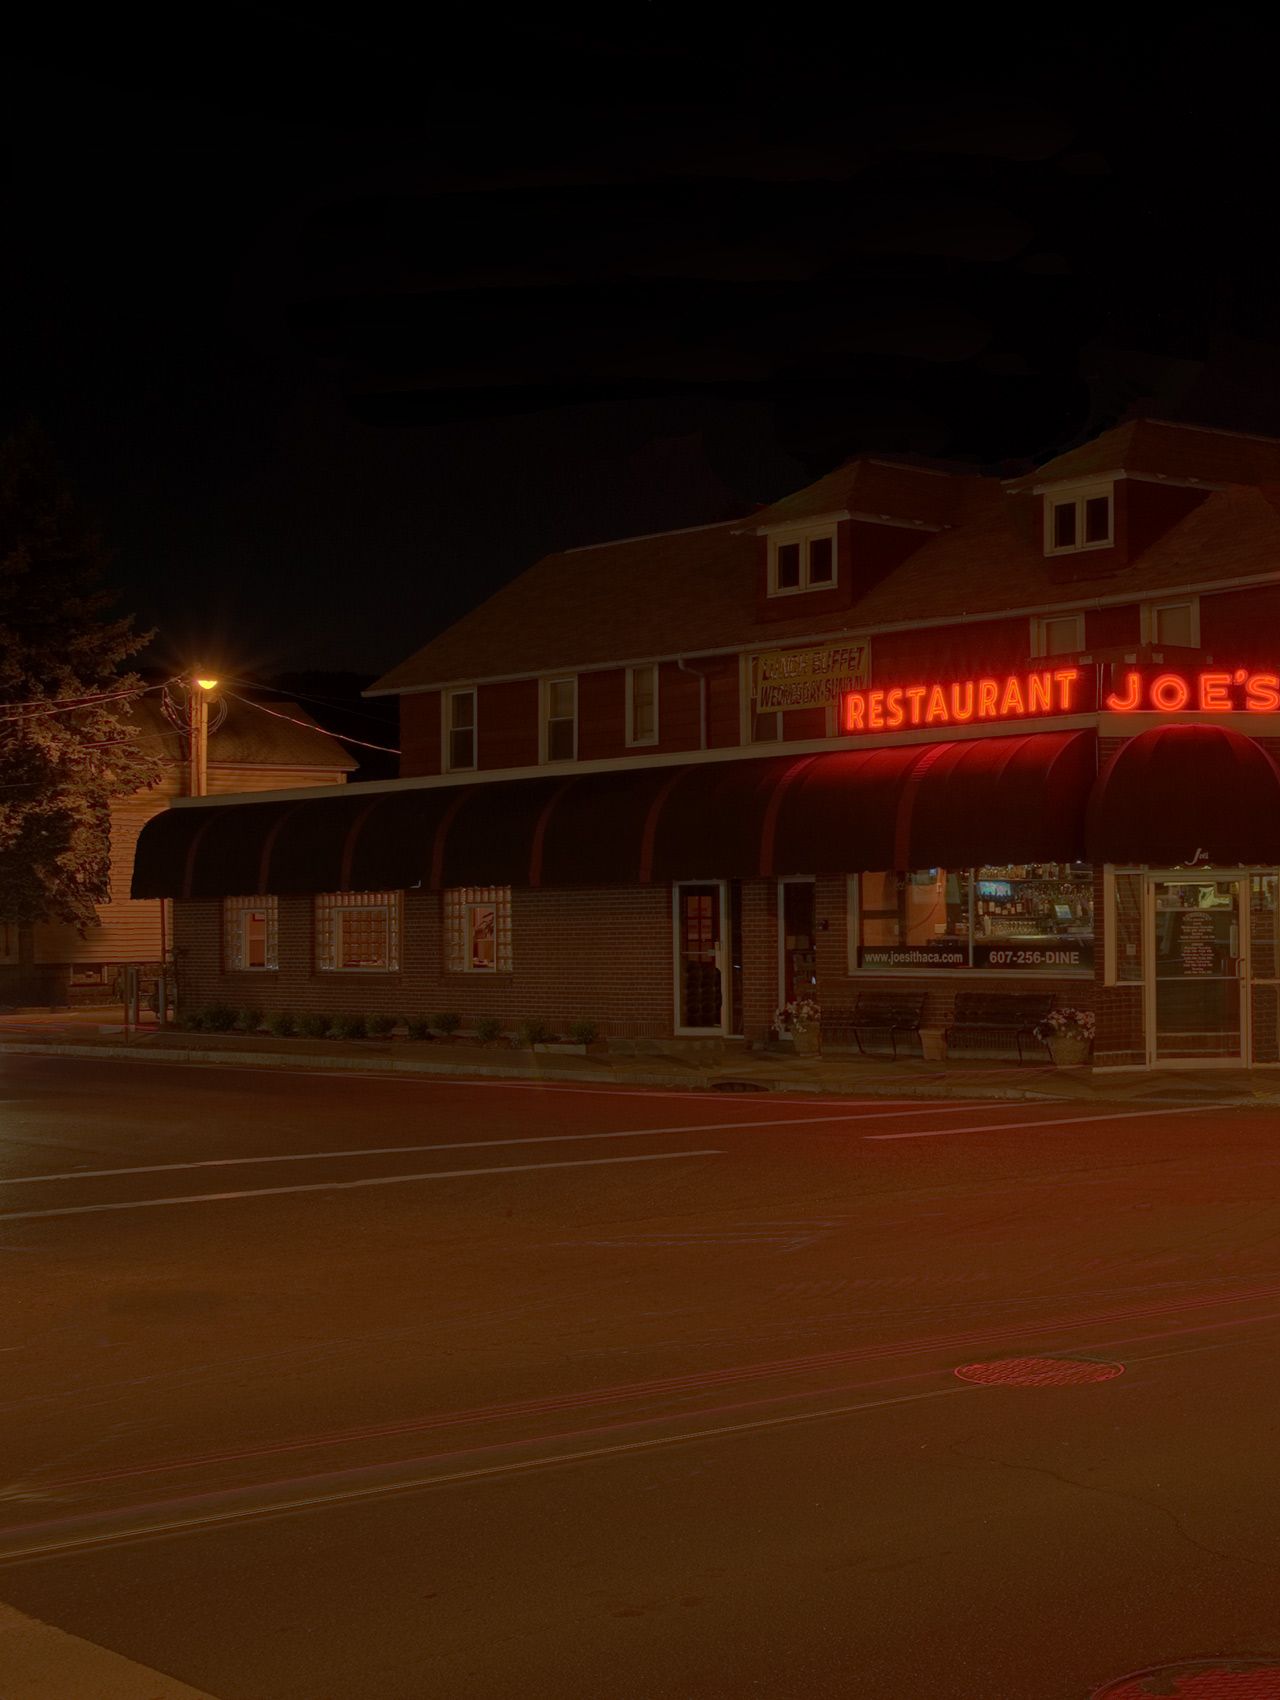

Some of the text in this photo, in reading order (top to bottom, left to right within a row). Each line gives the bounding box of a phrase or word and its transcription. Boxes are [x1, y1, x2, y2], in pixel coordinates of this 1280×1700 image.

[812, 646, 864, 675] BUFFET
[845, 668, 1078, 731] RESTAURANT
[864, 950, 963, 965] www.joesithaca.com
[988, 950, 1080, 965] 607-256-DINE
